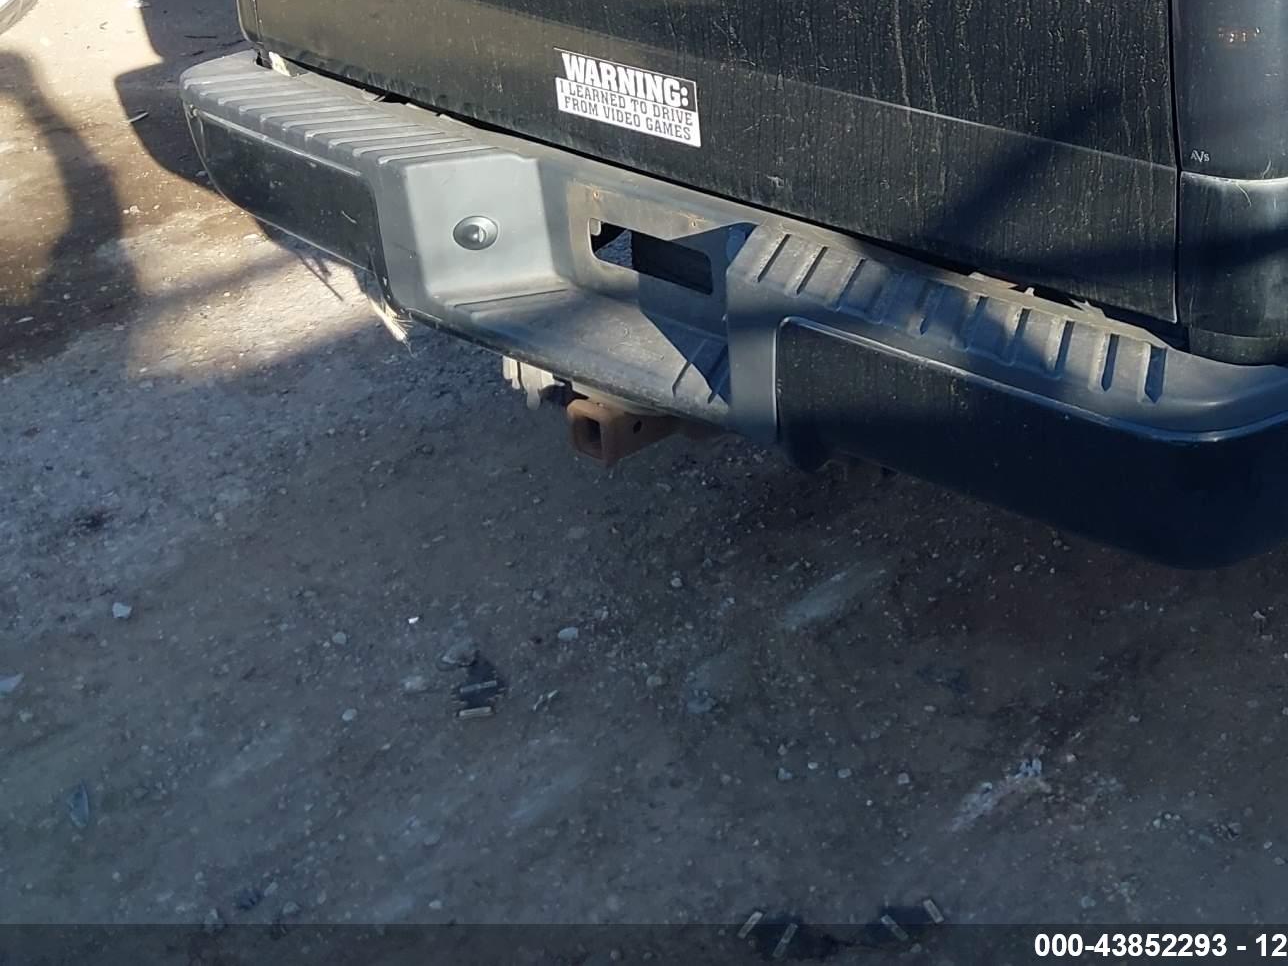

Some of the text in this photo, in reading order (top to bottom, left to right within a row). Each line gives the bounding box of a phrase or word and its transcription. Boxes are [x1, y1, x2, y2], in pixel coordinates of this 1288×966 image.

[560, 80, 694, 126] I LEARNED TO DRIVE
[561, 52, 689, 108] WARNING:
[564, 95, 692, 141] FROM VIDEO GAMES
